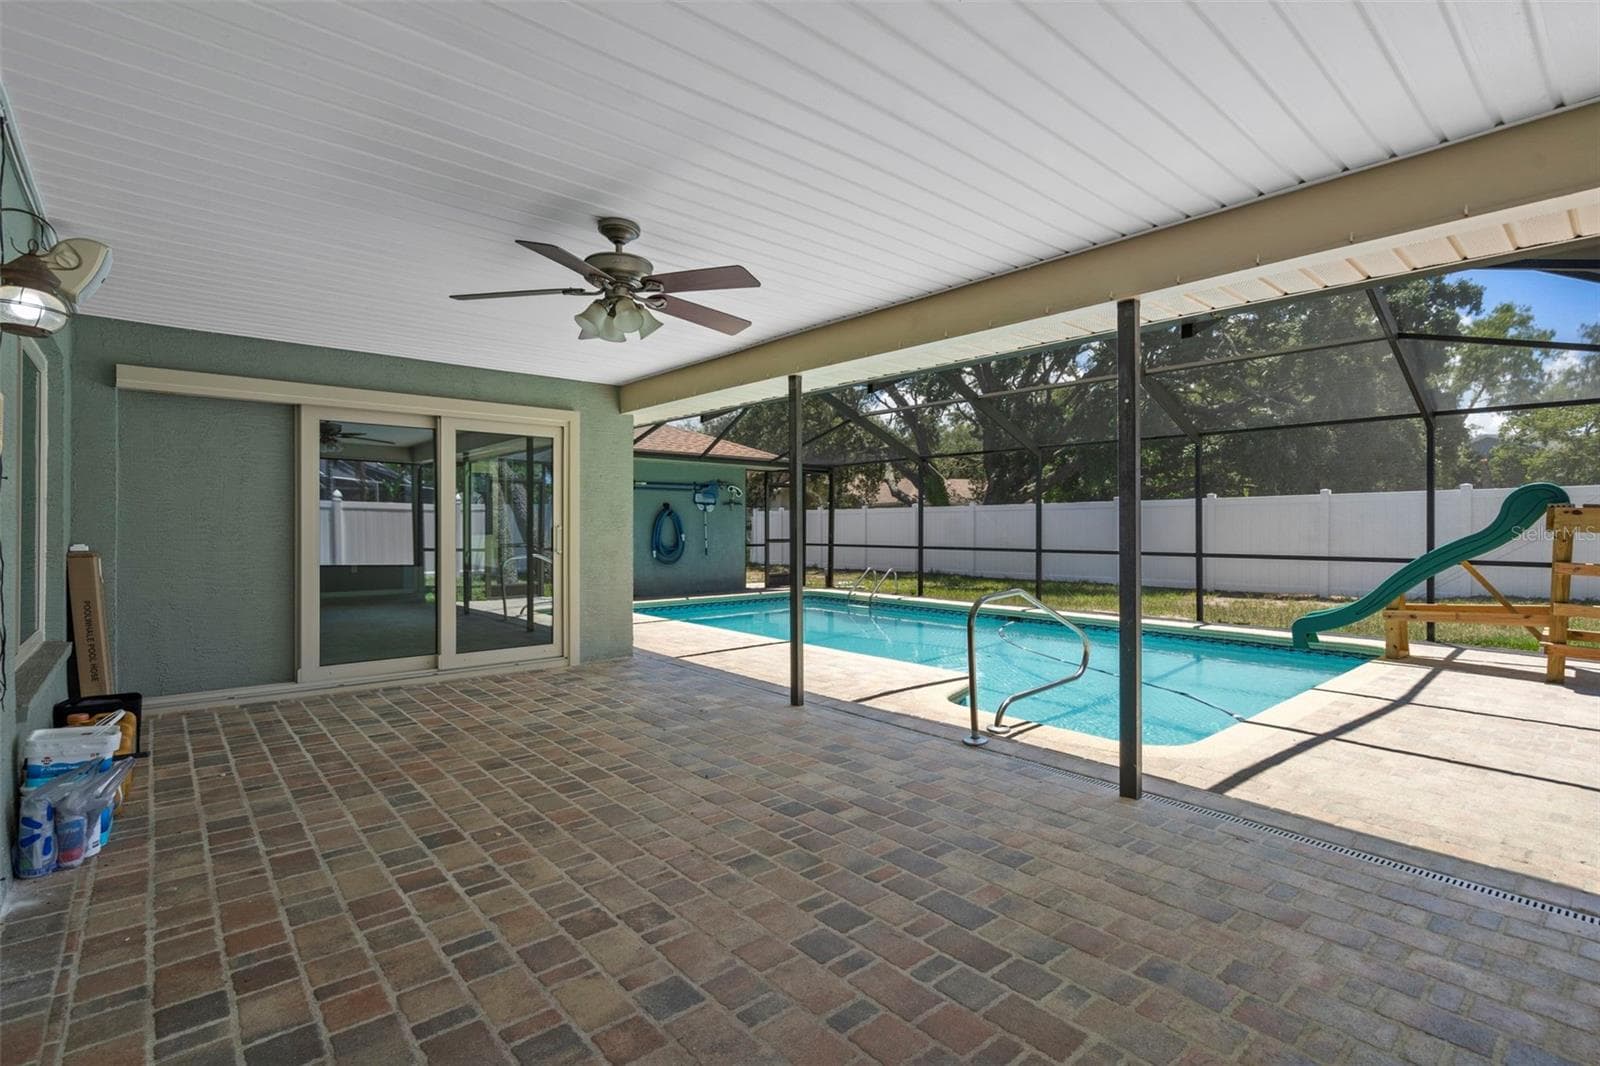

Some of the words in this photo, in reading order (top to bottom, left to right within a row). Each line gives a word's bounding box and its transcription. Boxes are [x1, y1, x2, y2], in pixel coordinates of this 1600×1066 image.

[83, 601, 95, 642] POOLWHALE
[87, 643, 96, 662] POOL
[90, 664, 99, 682] HOSE
